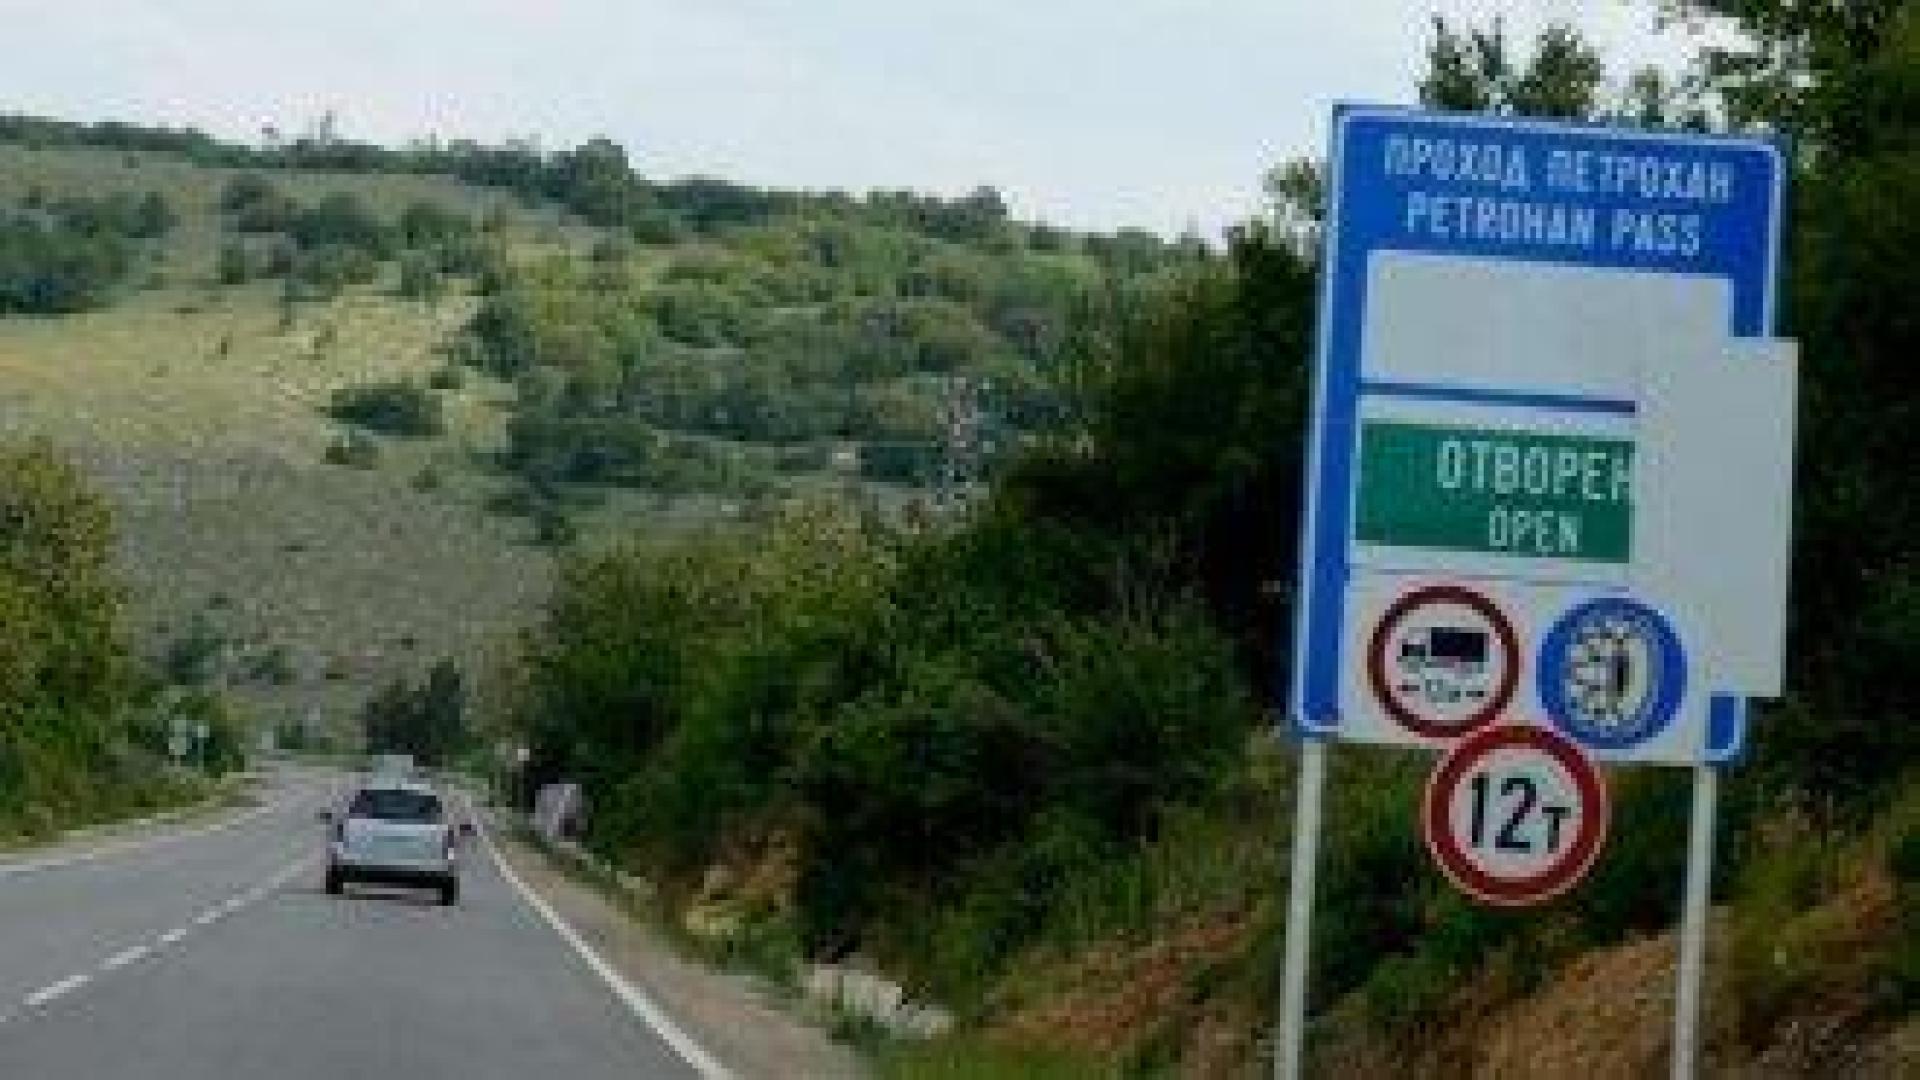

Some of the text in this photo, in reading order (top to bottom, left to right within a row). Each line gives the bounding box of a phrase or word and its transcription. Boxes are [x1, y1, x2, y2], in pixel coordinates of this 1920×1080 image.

[1384, 135, 1730, 204] ПРОХОД ПЕТРОХАН
[1407, 192, 1700, 256] PETROHAN PASS
[1489, 507, 1581, 552] OPEN
